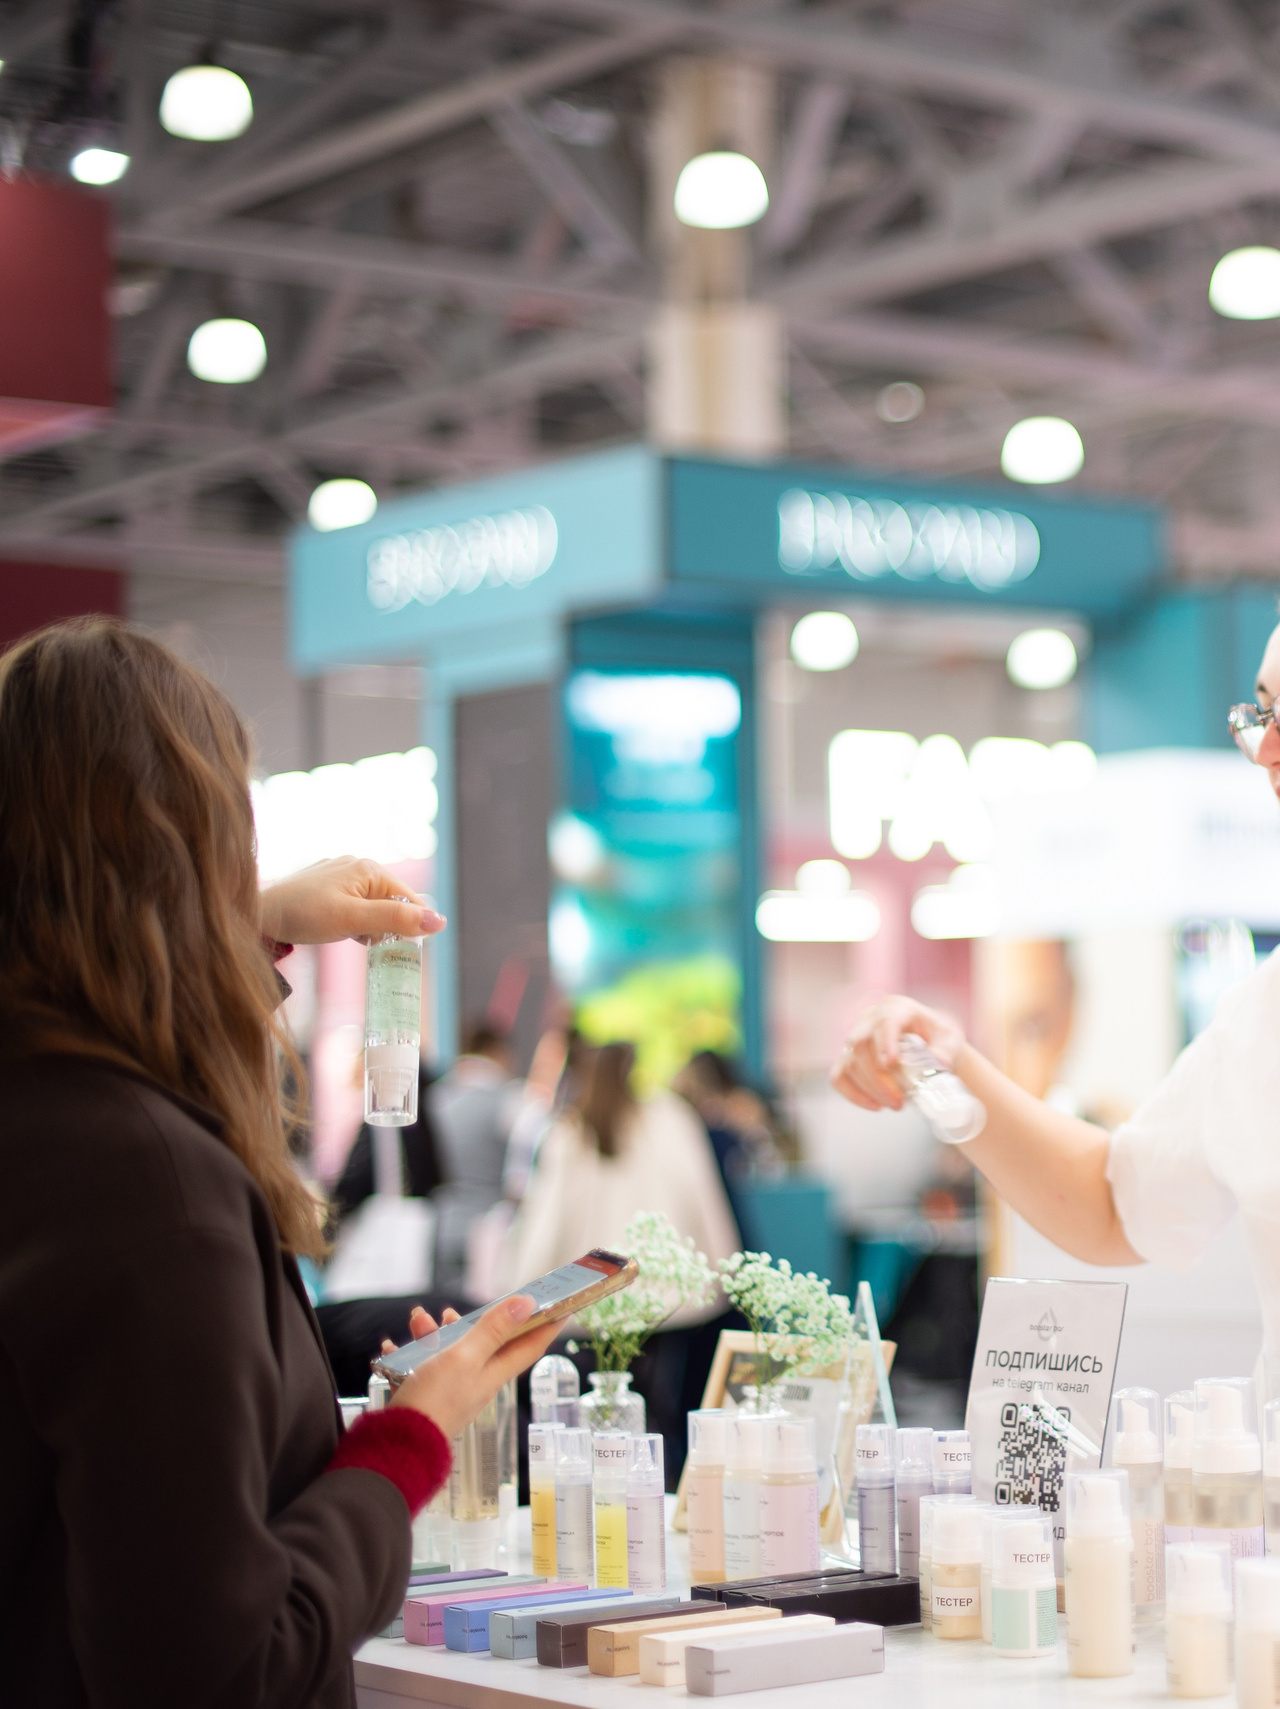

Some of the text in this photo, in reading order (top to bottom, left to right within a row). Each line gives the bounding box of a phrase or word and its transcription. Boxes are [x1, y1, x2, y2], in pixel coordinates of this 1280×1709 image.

[985, 1350, 1103, 1373] ПОДПИШИСЬ
[992, 1377, 1089, 1394] на telegram канал
[1013, 1553, 1051, 1564] ТЕСТЕР
[1144, 1521, 1155, 1602] booster bar
[936, 1597, 973, 1608] ТЕСТЕР
